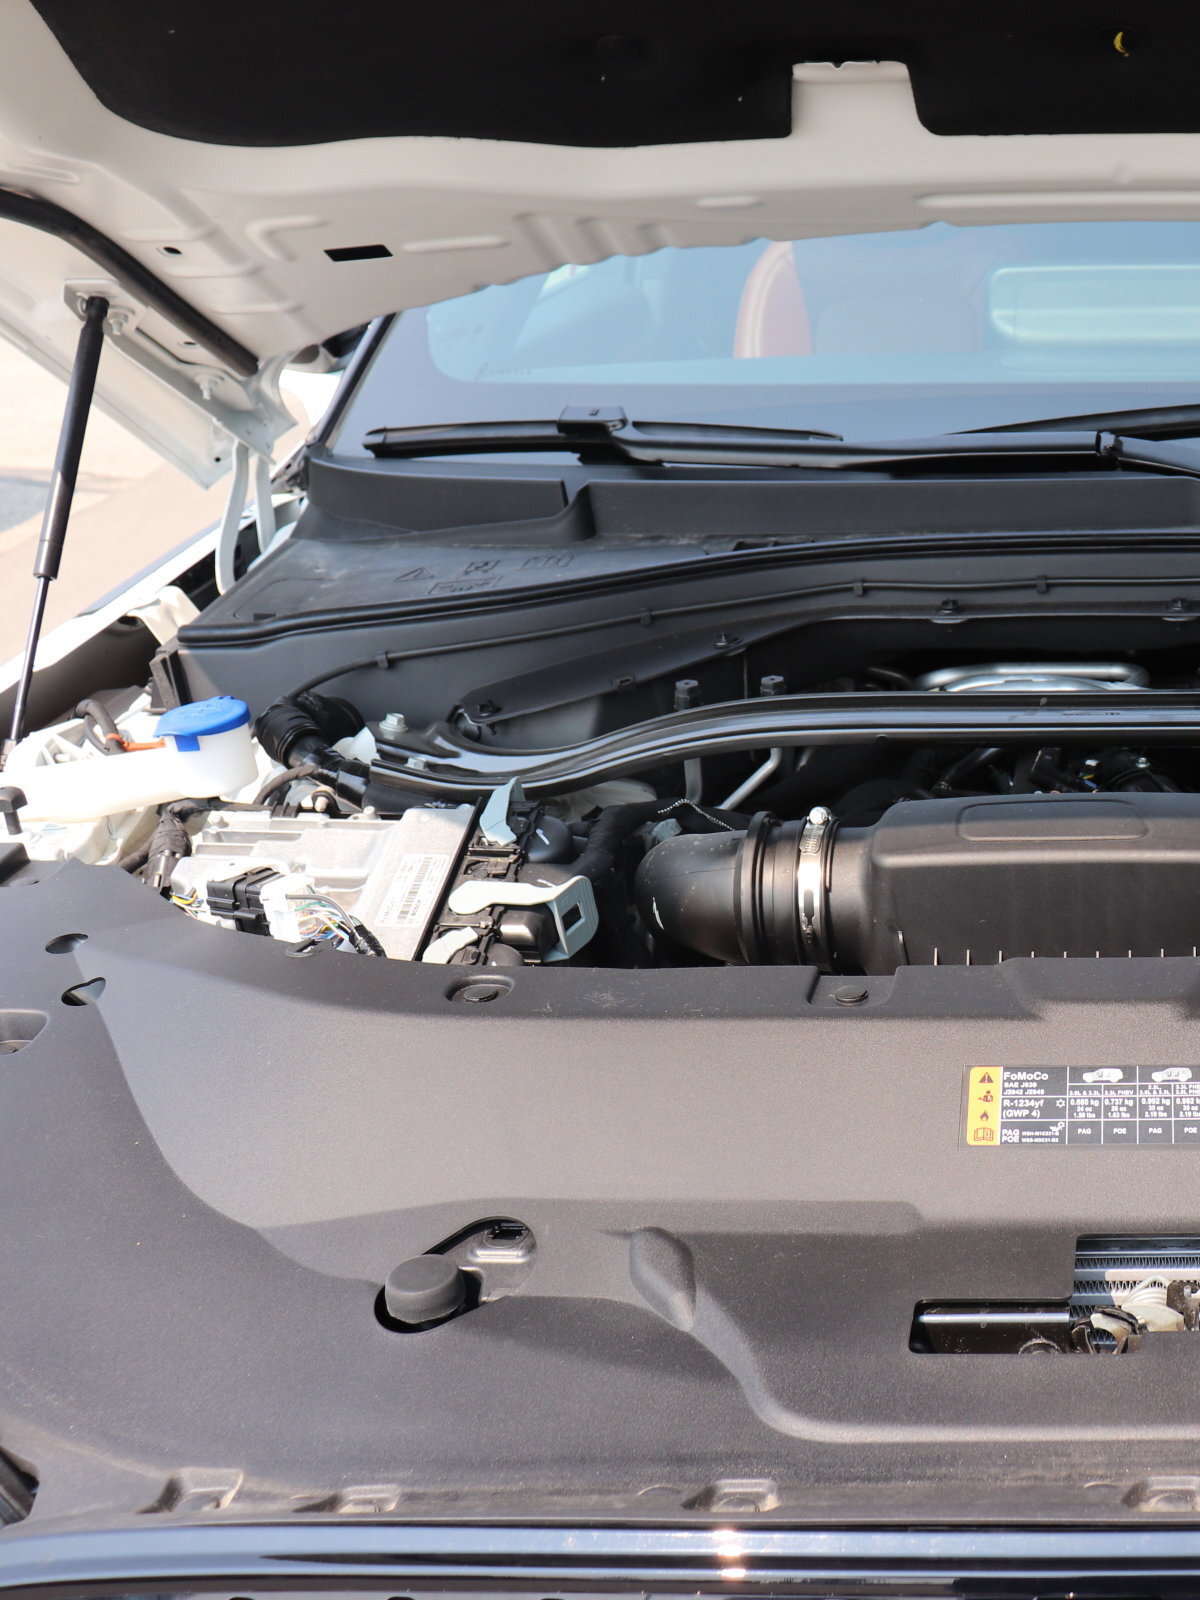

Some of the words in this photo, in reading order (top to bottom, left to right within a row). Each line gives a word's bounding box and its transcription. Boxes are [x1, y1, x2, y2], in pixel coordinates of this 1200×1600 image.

[1004, 1072, 1048, 1080] FoMoCo
[1003, 1099, 1044, 1108] R-1234yf
[1003, 1109, 1029, 1118] (GWP
[1031, 1109, 1040, 1118] 4)
